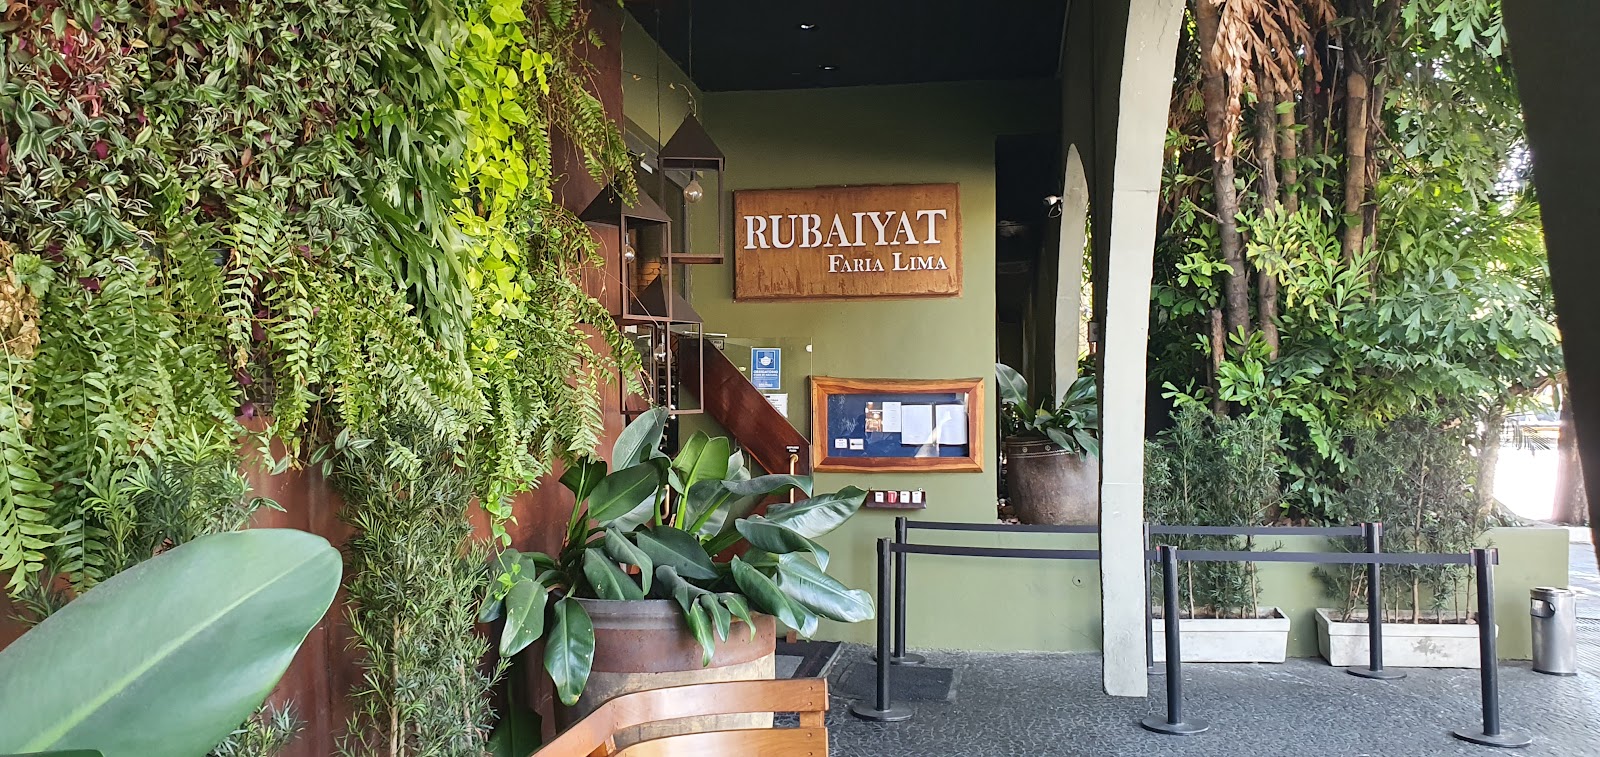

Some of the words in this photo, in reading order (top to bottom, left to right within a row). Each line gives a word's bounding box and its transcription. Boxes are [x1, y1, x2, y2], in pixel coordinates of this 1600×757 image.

[743, 209, 947, 249] RUBAIYAT
[828, 254, 885, 273] FARIA
[892, 252, 948, 271] LIMA
